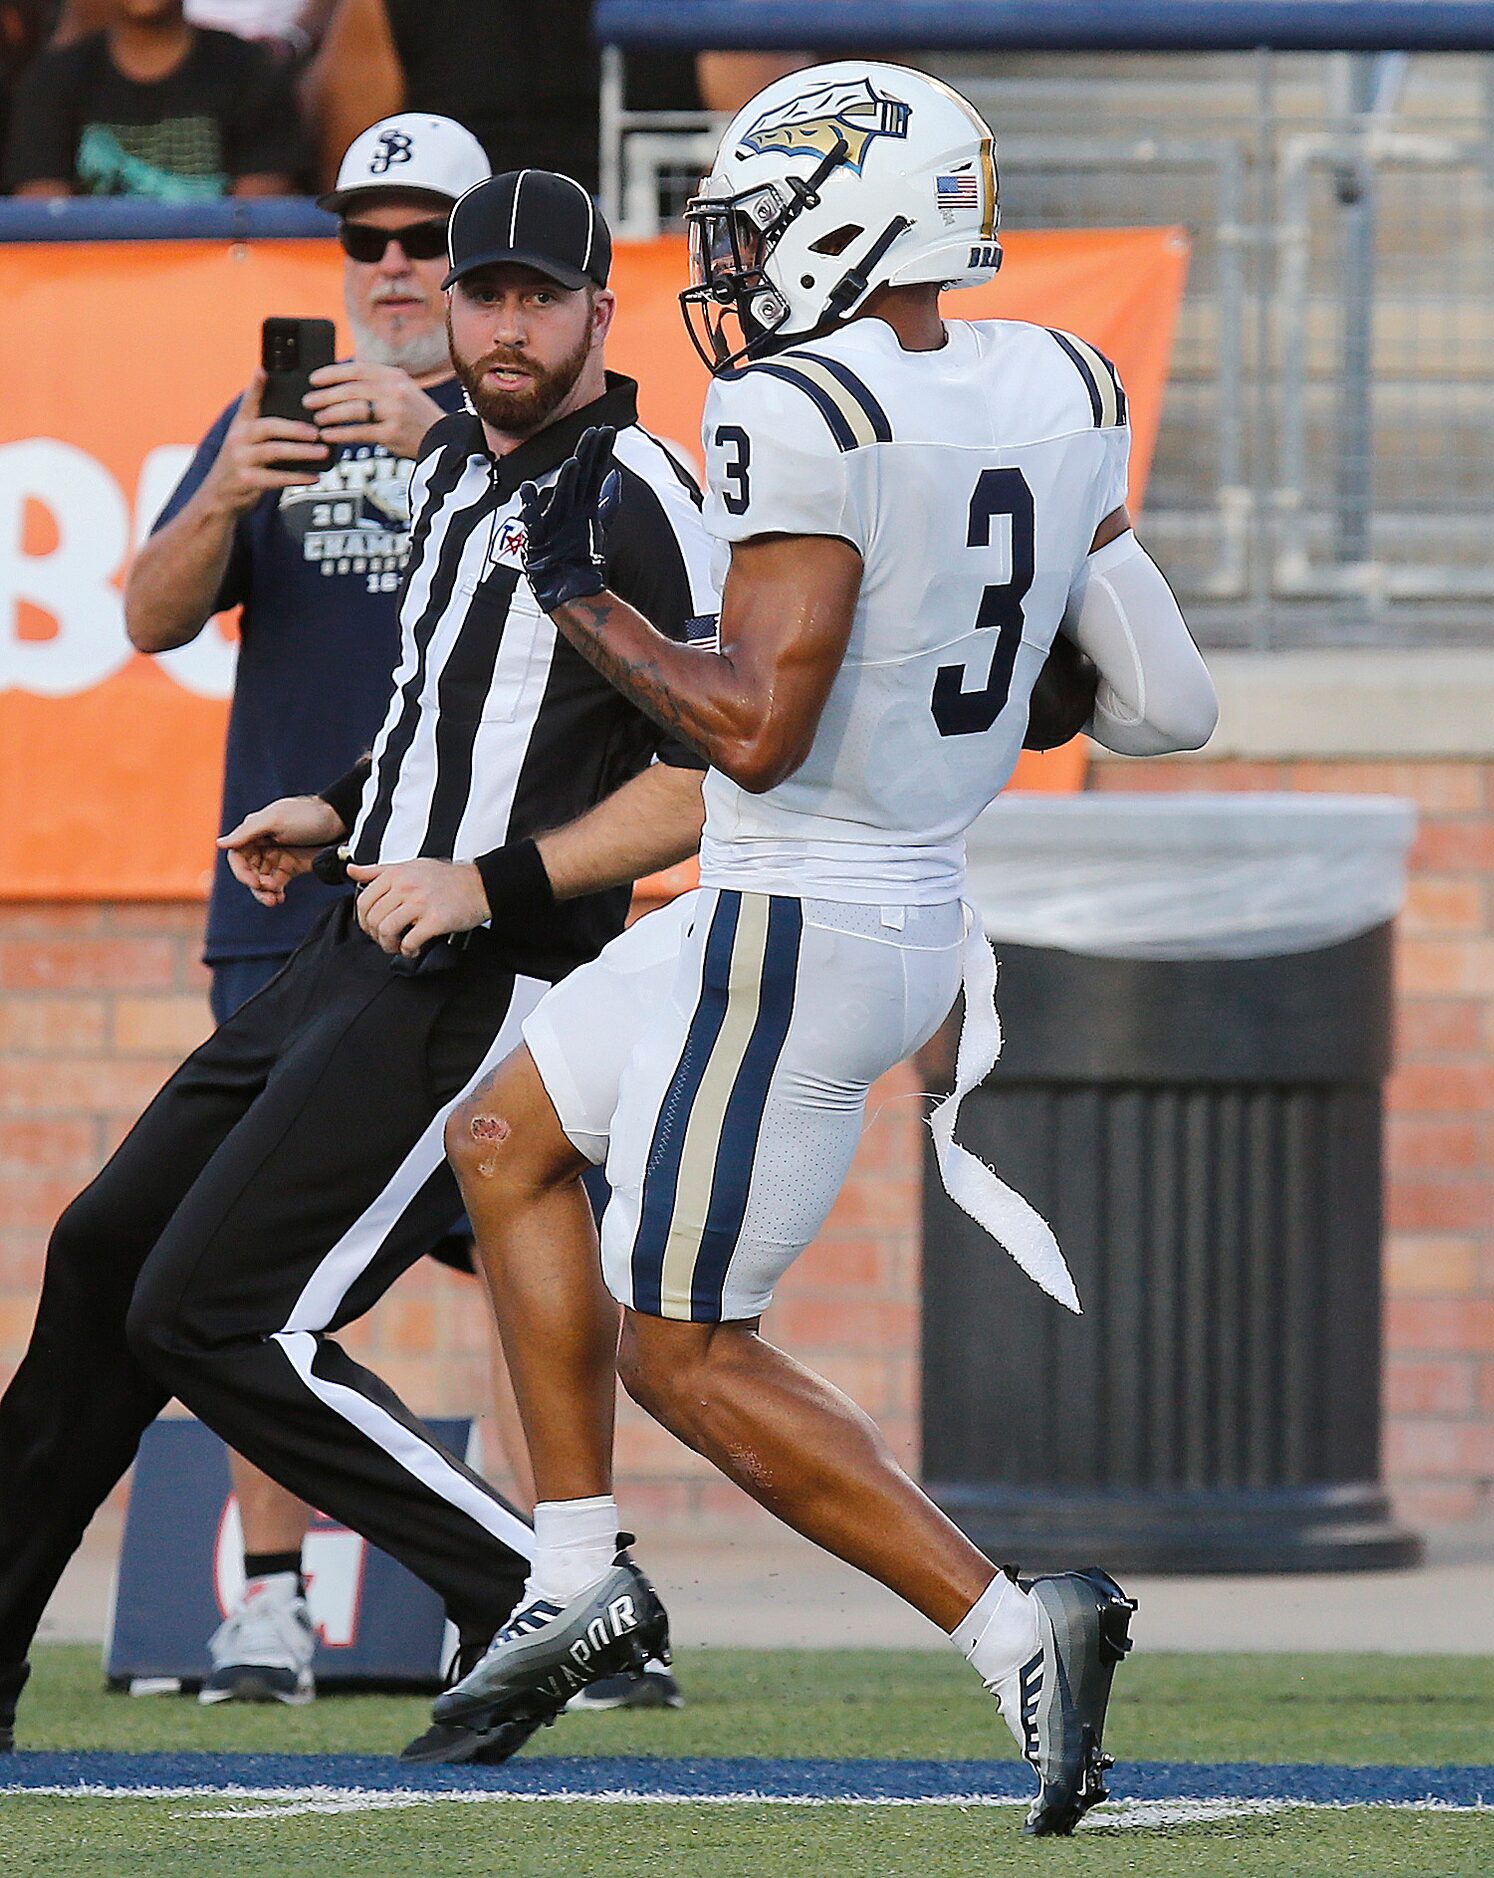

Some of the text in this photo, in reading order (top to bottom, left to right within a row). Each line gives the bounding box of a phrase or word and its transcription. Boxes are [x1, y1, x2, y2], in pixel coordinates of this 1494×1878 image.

[714, 425, 750, 516] 3
[930, 466, 1035, 738] 3
[536, 1593, 639, 1698] VAPOR
